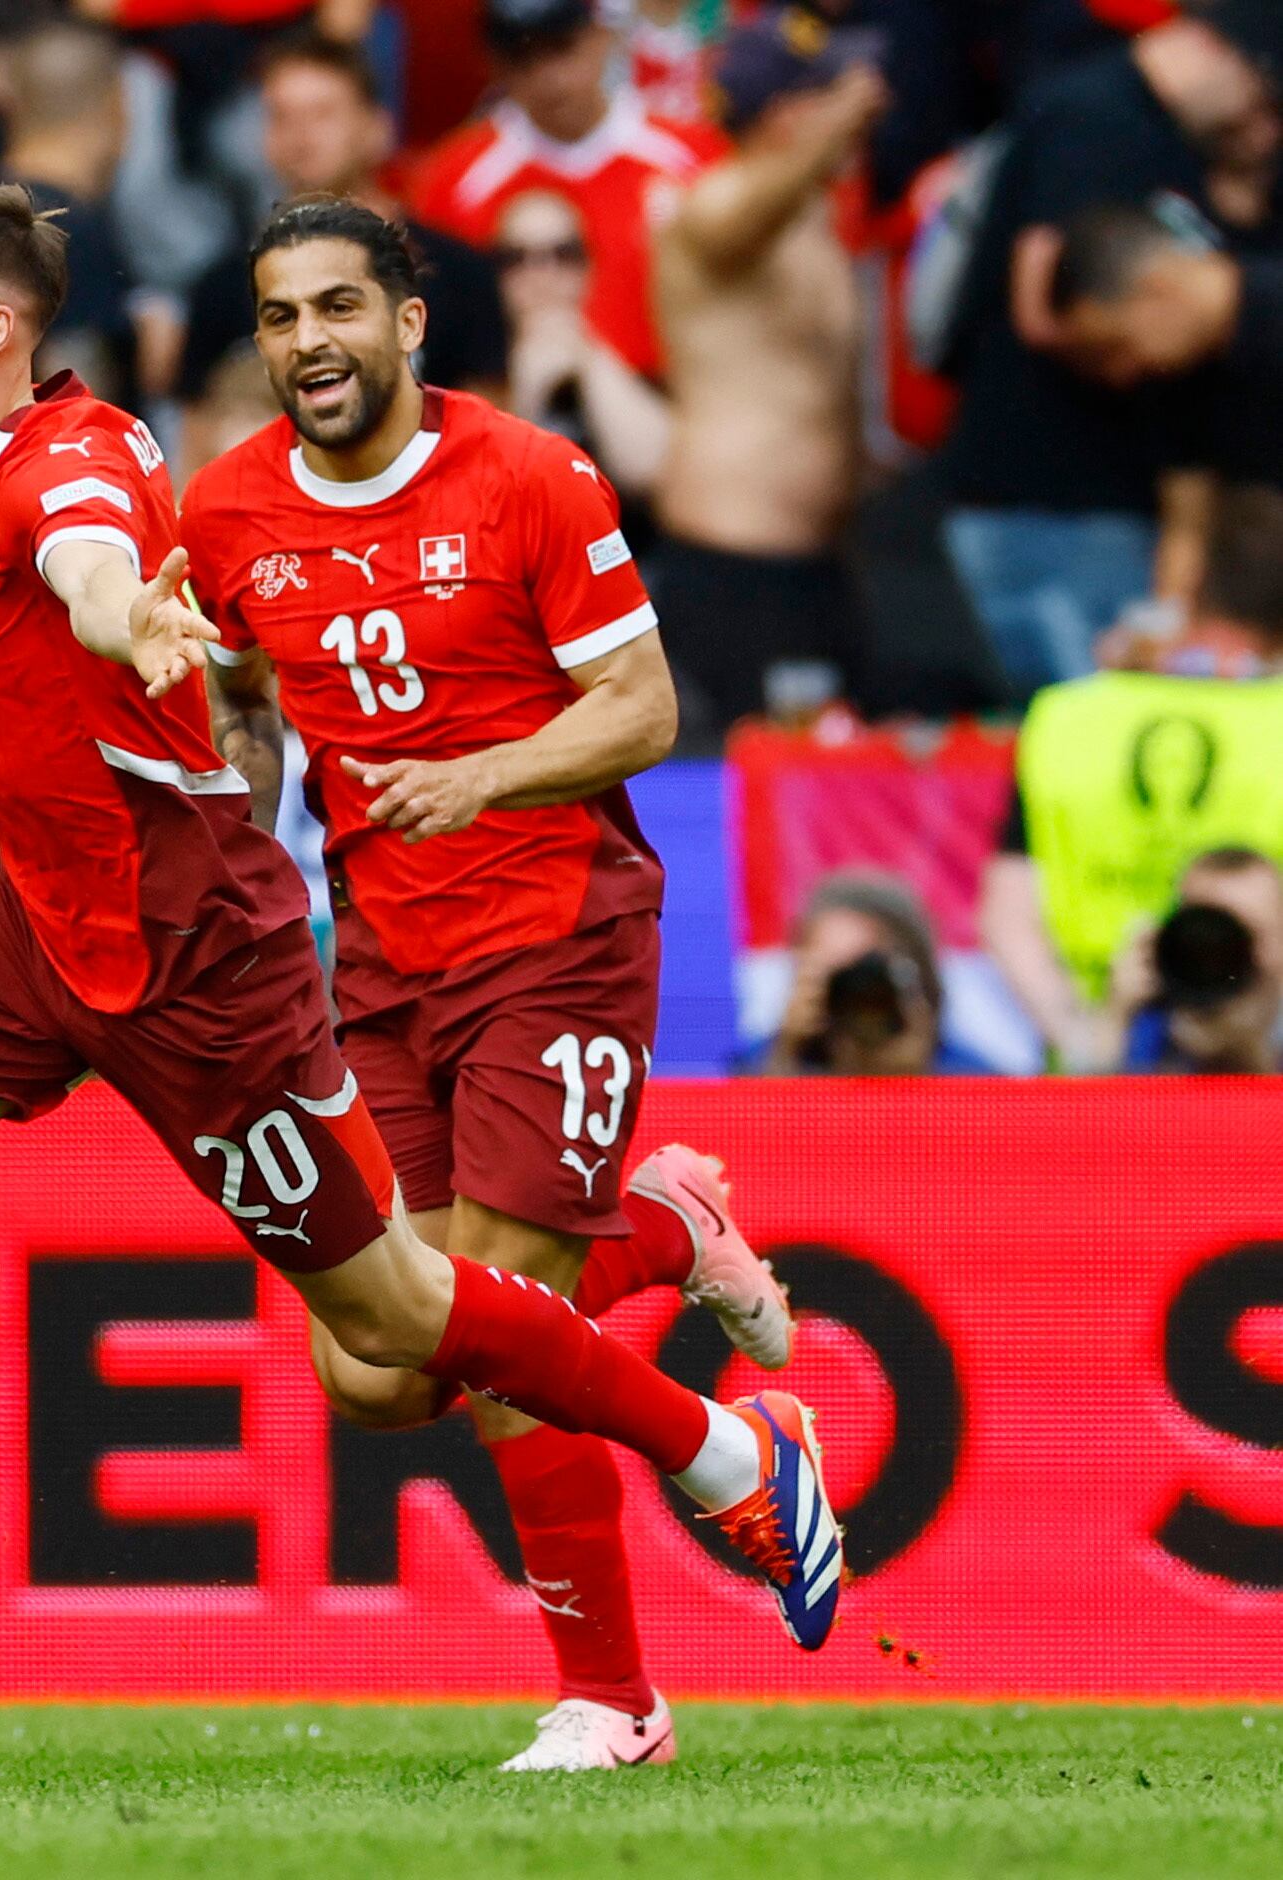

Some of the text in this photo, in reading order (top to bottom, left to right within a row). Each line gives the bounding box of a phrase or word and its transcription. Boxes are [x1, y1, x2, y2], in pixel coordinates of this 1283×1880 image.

[320, 609, 425, 716] 13
[541, 1033, 631, 1147] 13
[193, 1109, 319, 1218] 20
